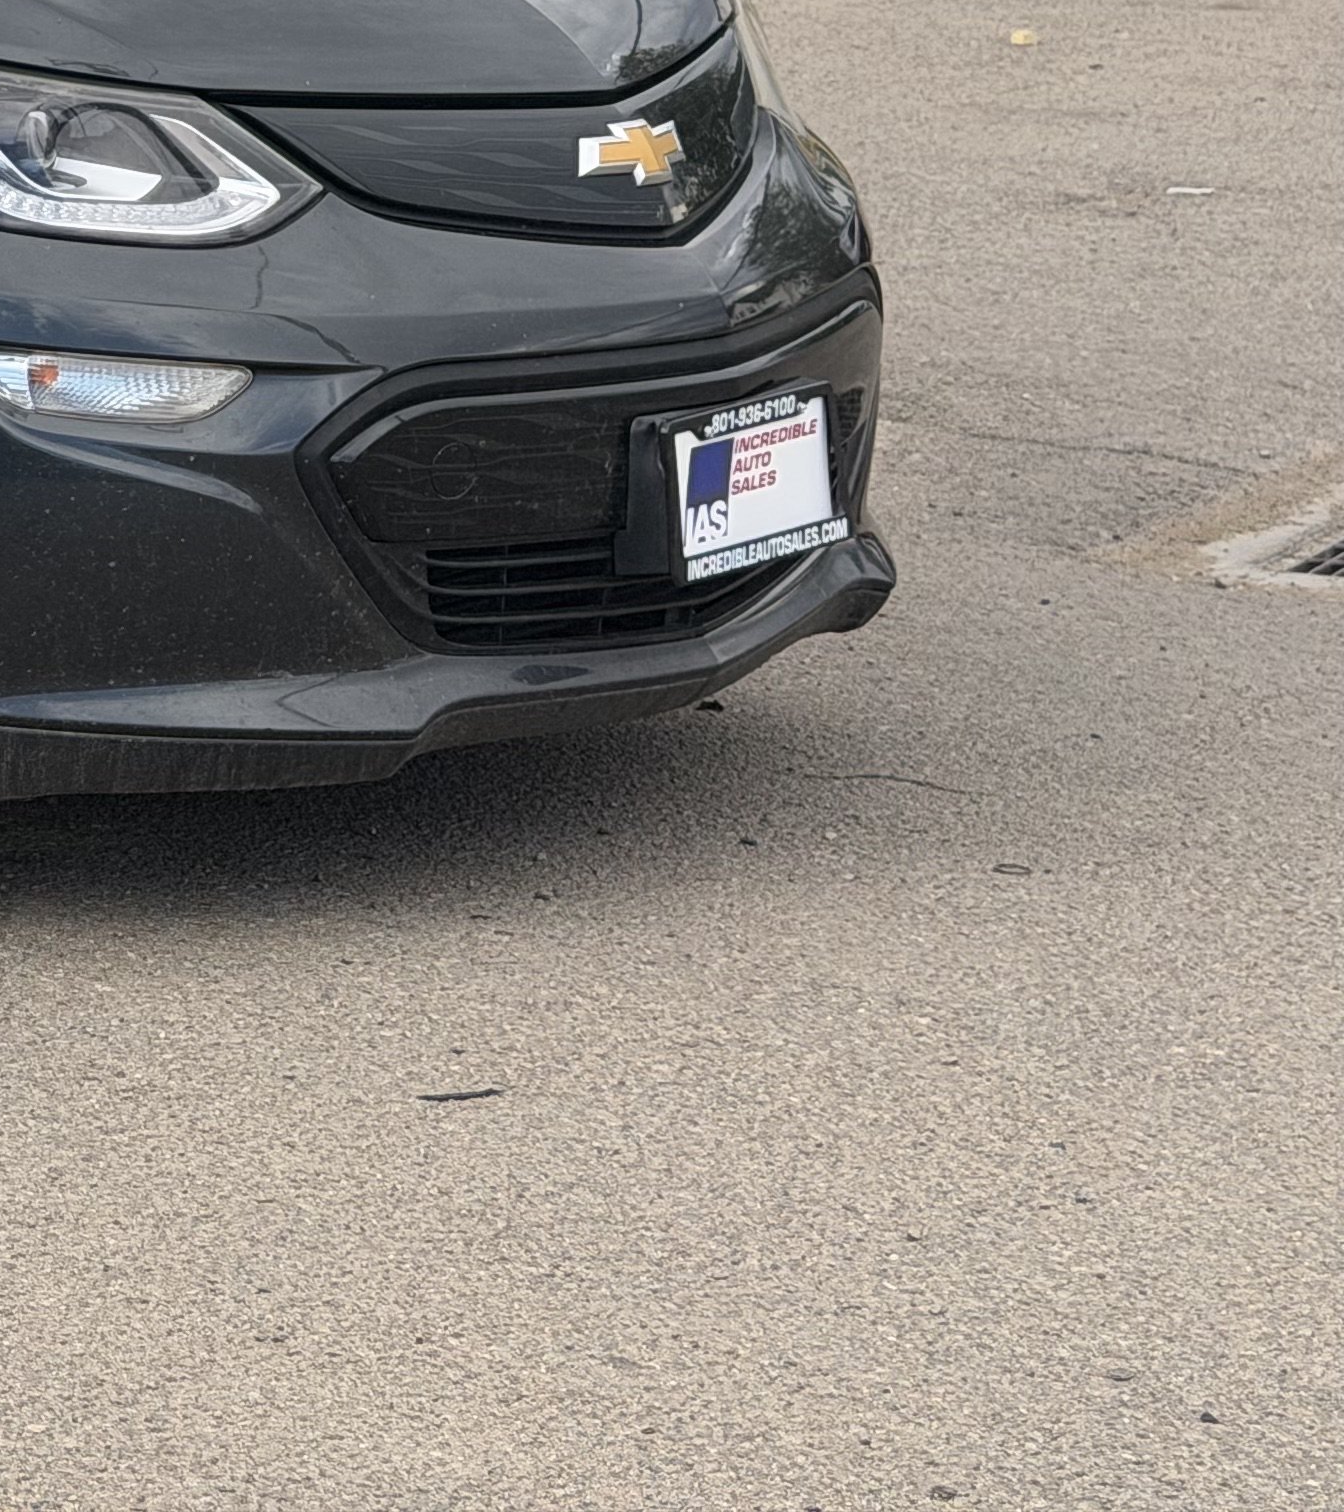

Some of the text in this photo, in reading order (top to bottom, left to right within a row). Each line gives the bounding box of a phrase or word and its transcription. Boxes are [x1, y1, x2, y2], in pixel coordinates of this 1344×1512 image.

[712, 394, 796, 434] 801-936-6100
[734, 418, 818, 454] INCREDIBLE
[733, 450, 772, 475] AUTO
[731, 469, 777, 496] SALES
[685, 499, 727, 548] IAS
[687, 517, 849, 582] INCREDIBLEAUTOSALES.COM
